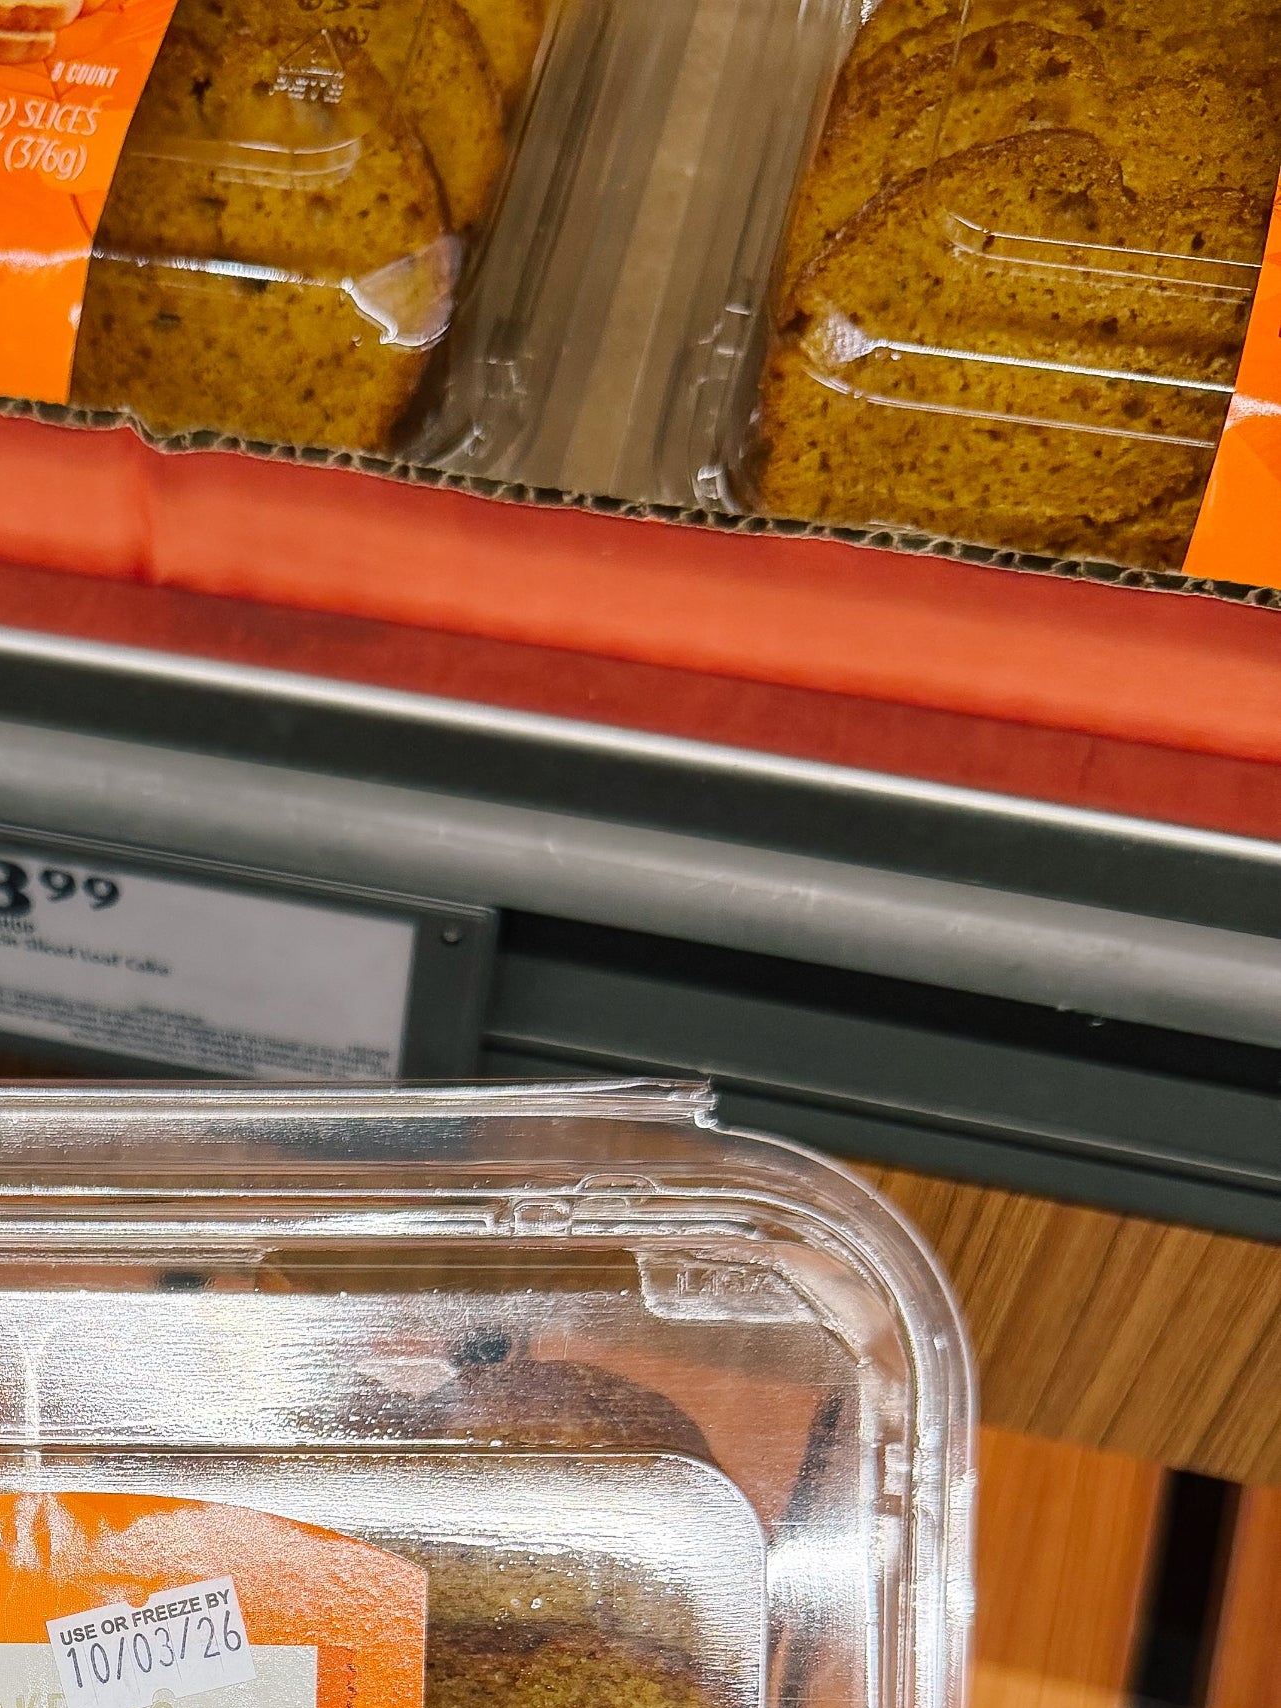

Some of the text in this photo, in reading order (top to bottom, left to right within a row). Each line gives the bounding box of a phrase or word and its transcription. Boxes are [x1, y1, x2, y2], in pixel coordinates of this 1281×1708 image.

[67, 62, 119, 88] COUNT
[18, 100, 101, 136] SLICES
[4, 134, 88, 182] (376g)
[59, 1588, 230, 1646] USE OR FREEZE BY
[66, 1609, 242, 1689] 10/03/26
